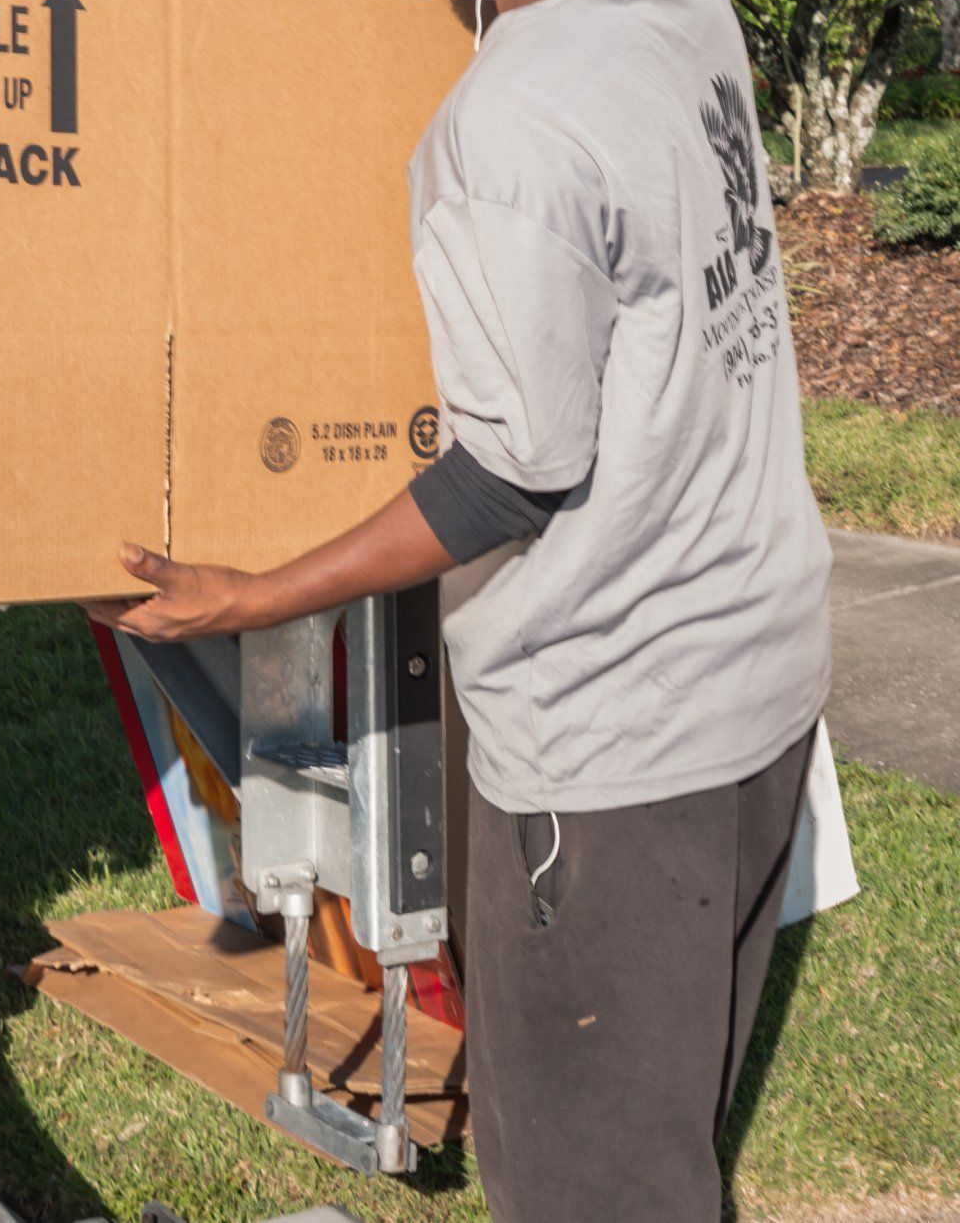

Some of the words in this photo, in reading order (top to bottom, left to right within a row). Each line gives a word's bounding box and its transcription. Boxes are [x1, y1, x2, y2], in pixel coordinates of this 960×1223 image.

[4, 77, 33, 110] UP
[311, 422, 331, 441] 5.2
[333, 422, 361, 440] DISH
[364, 421, 397, 438] PLAIN
[322, 445, 336, 463] 18
[349, 445, 362, 462] 18
[374, 444, 388, 462] 28
